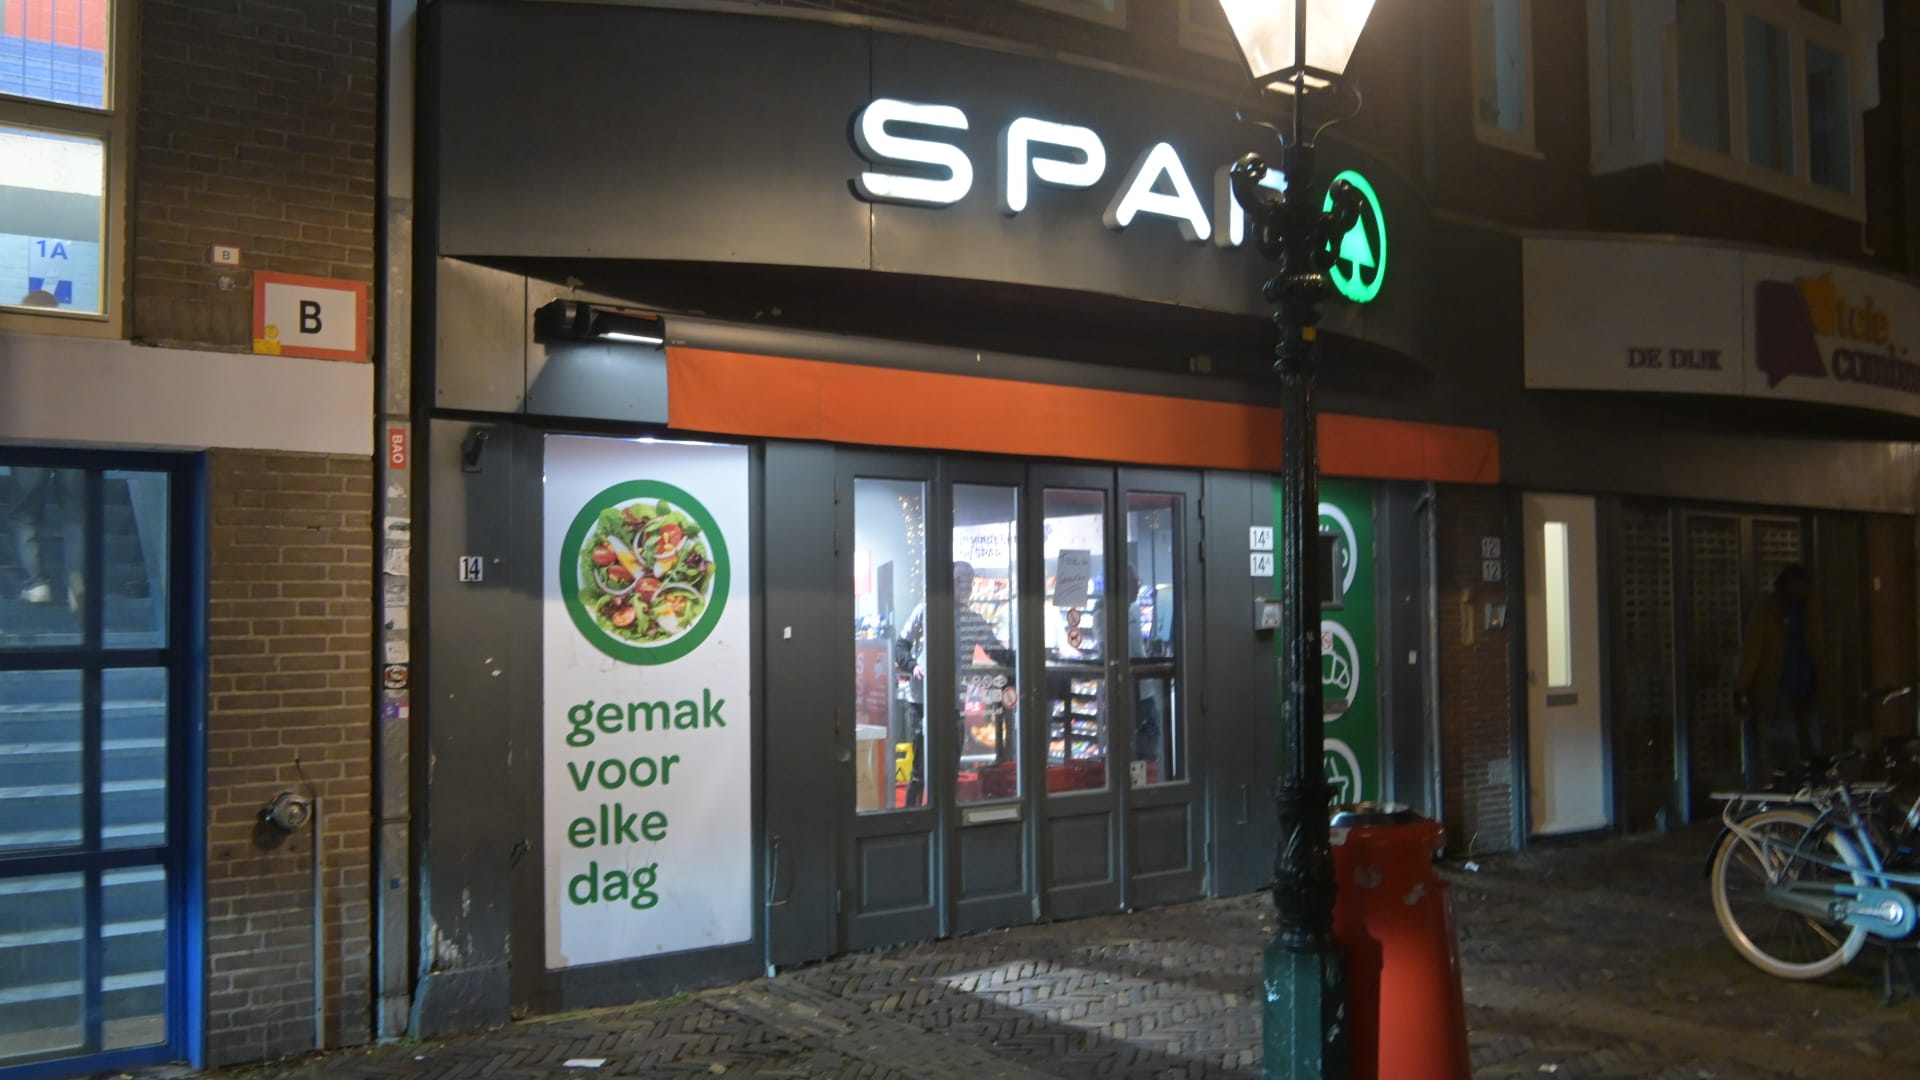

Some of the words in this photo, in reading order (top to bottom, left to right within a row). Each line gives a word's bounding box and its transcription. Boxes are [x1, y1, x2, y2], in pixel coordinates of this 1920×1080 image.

[36, 239, 68, 260] 1A
[222, 250, 231, 261] B
[299, 299, 323, 335] B
[1627, 348, 1662, 368] DE
[392, 434, 404, 464] BAO
[463, 558, 480, 580] 14
[565, 688, 726, 747] gemak
[567, 754, 680, 791] voor
[568, 803, 667, 848] elke
[568, 861, 658, 909] dag
